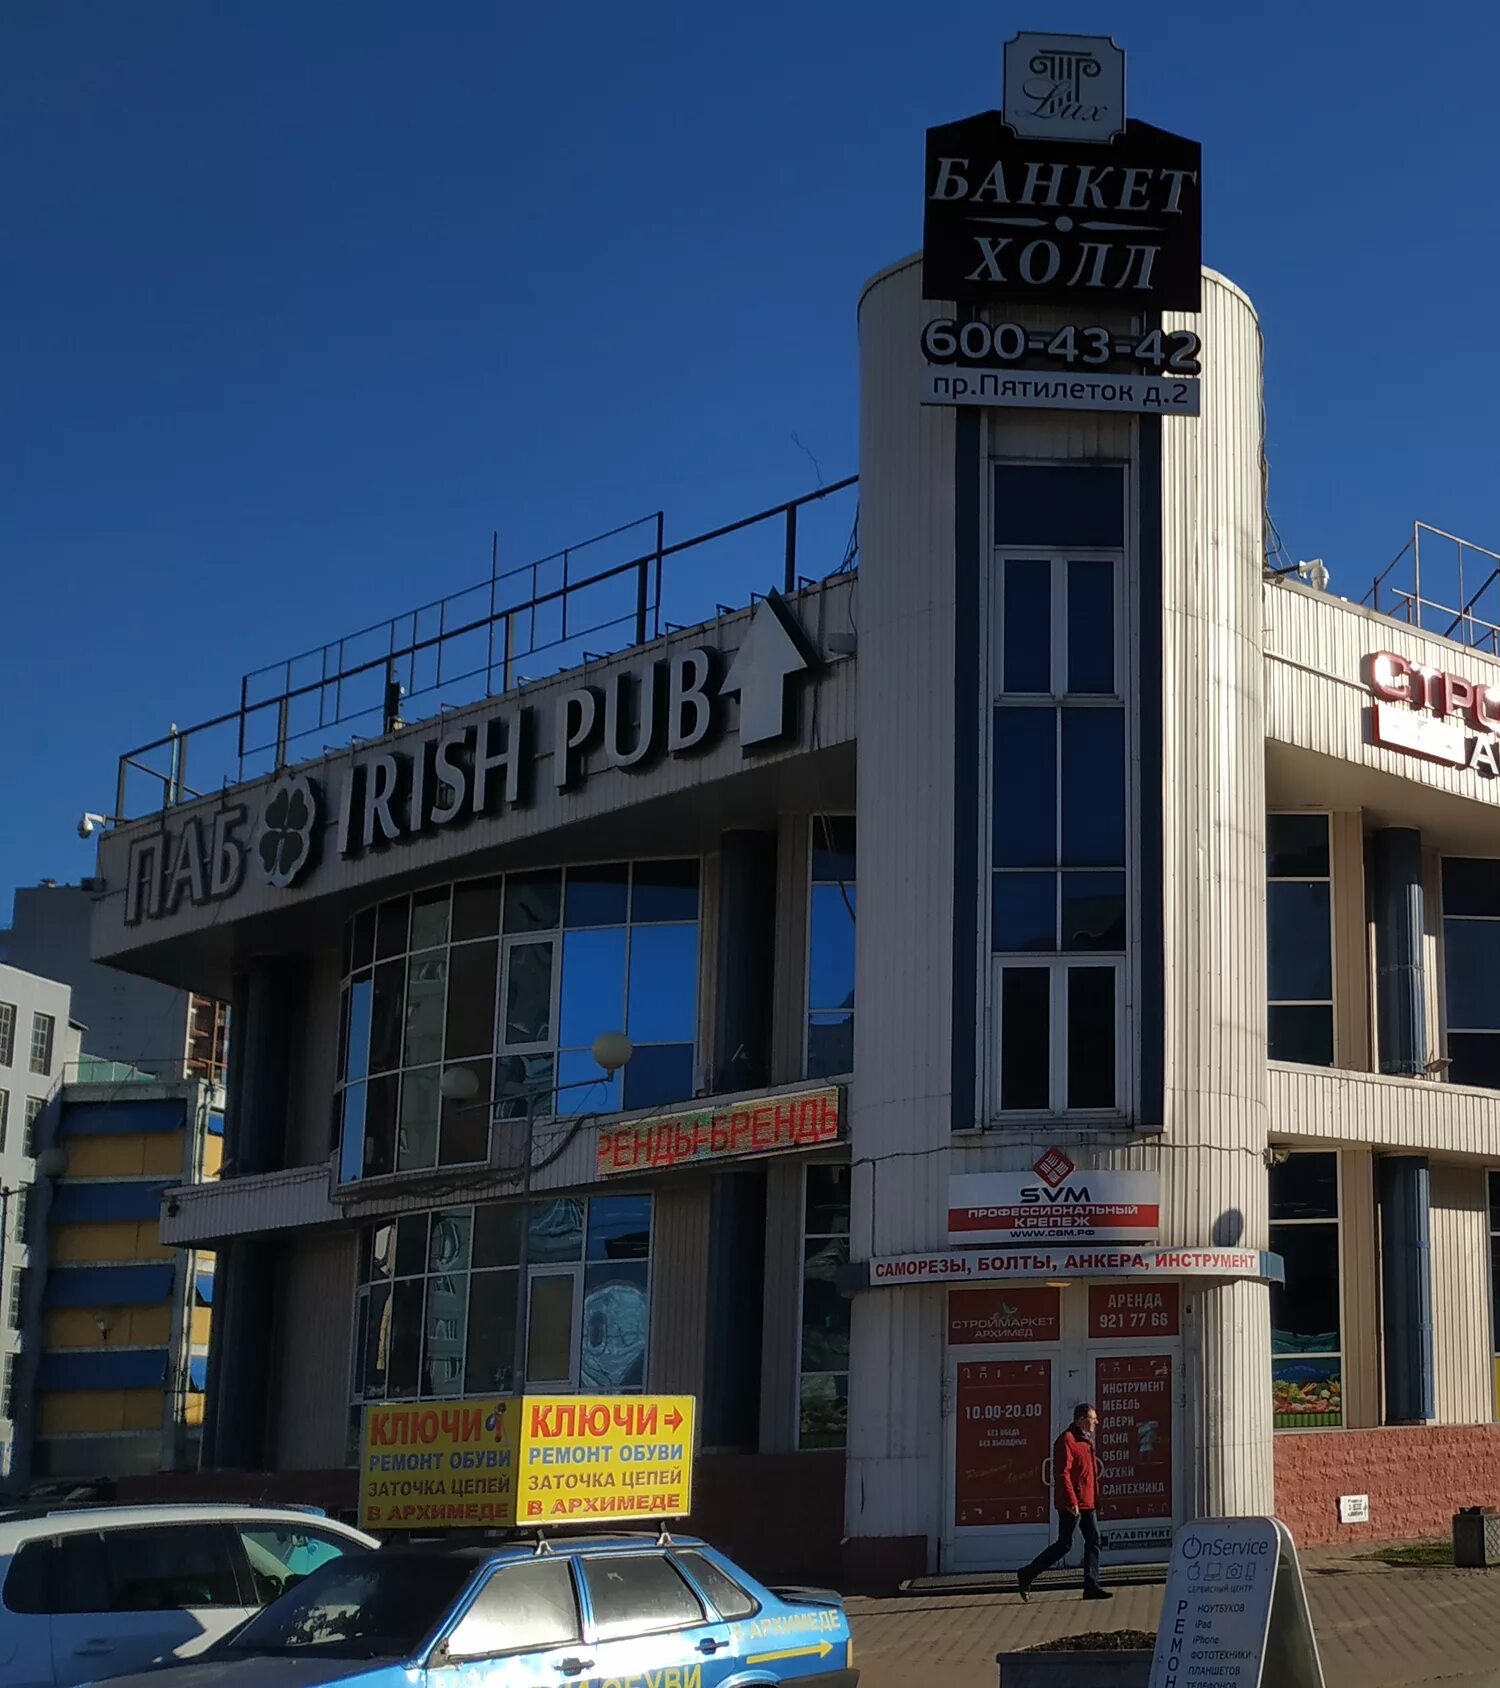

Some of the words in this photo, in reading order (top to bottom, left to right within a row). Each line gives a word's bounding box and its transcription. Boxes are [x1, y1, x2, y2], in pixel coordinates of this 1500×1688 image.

[929, 157, 1197, 215] БАНКЕТ
[965, 237, 1161, 290] ХОЛЛ
[925, 321, 1199, 368] 600-43-42
[933, 374, 1134, 402] пр.Пятилеток
[1143, 383, 1188, 406] д.2
[336, 709, 528, 856] IRISH
[556, 648, 718, 788] PUB
[124, 803, 248, 926] ПАБ
[1020, 1187, 1091, 1203] SVM
[968, 1204, 1138, 1219] ПРОФЕССИОНАЛЬНЫЙ
[1014, 1217, 1090, 1228] КРЕПЕЖ
[875, 1258, 972, 1277] САМОРЕЗЫ,
[978, 1255, 1057, 1273] БОЛТЫ,
[1065, 1253, 1151, 1270] АНКЕРА,
[1155, 1253, 1256, 1270] ИНСТРУМЕНТ
[1108, 1293, 1163, 1309] АРЕНДА
[952, 1317, 1055, 1329] СТРОЙМАРКЕТ
[1100, 1313, 1124, 1329] 921
[1130, 1313, 1147, 1328] 77
[1151, 1312, 1169, 1327] 66
[974, 1329, 1034, 1338] АРХИМЕД
[1102, 1381, 1165, 1394] ИНСТРУМЕНТ
[965, 1403, 1042, 1420] 10.00-20.00
[1102, 1399, 1140, 1410] МЕБЕЛЬ
[370, 1407, 482, 1446] КЛЮЧИ
[530, 1404, 658, 1438] КЛЮЧИ
[1102, 1416, 1134, 1429] ДВЕРИ
[1102, 1433, 1129, 1444] ОКНА
[369, 1452, 443, 1472] РЕМОНТ
[449, 1451, 511, 1470] ОБУВИ
[528, 1446, 613, 1465] РЕМОНТ
[619, 1443, 684, 1462] ОБУВИ
[1102, 1450, 1130, 1461] ОБОИ
[527, 1472, 616, 1490] ЗАТОЧКА
[621, 1466, 682, 1487] ЦЕПЕЙ
[1102, 1466, 1134, 1478] КУХНИ
[368, 1479, 445, 1497] ЗАТОЧКА
[451, 1473, 510, 1497] ЦЕПЕЙ
[1102, 1483, 1165, 1495] САНТЕХНИКА
[366, 1505, 381, 1521] В
[387, 1502, 509, 1521] АРХИМЕДЕ
[527, 1500, 543, 1516] В
[551, 1494, 681, 1513] АРХИМЕДЕ
[1182, 1534, 1268, 1559] OnService
[1187, 1584, 1229, 1593] СЕРВИСНЫЙ
[1230, 1584, 1253, 1593] ЦЕНТР
[1197, 1603, 1245, 1613] НОУТБУКОВ
[750, 1609, 841, 1639] АРХИМЕДЕ
[1195, 1619, 1212, 1629] iPad
[1192, 1634, 1219, 1645] iPhone
[1190, 1650, 1251, 1660] ФОТОТЕХНИКИ
[1188, 1665, 1241, 1676] ПЛАНШЕТОВ
